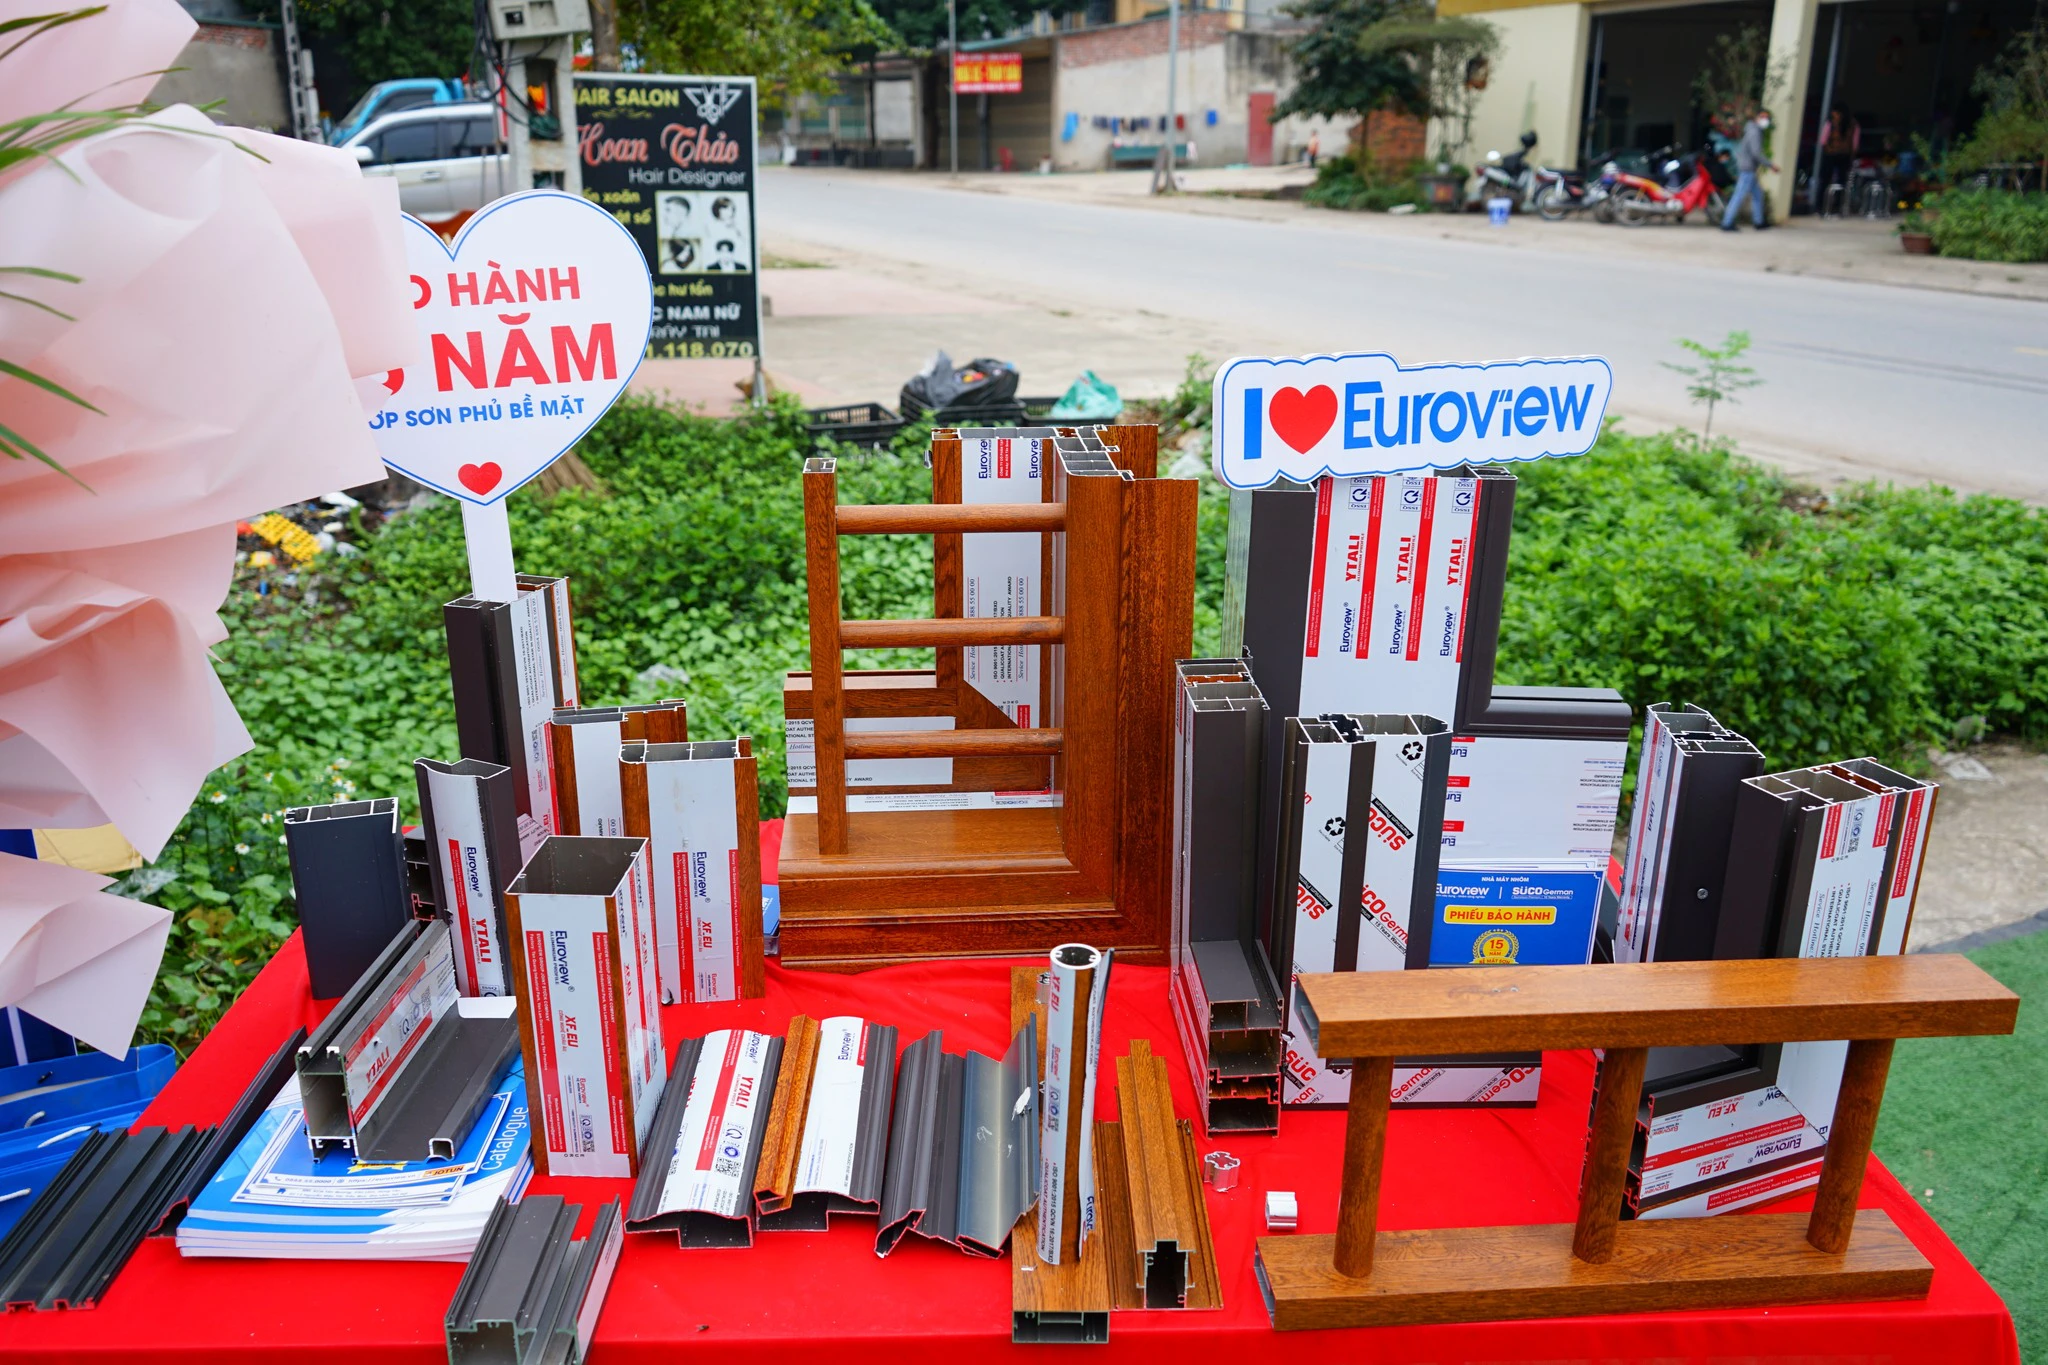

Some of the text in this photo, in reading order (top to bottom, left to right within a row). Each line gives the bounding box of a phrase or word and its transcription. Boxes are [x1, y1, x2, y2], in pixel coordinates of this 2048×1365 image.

[615, 88, 679, 106] SALON
[577, 123, 649, 166] Hoan
[629, 168, 745, 187] Hair Designer
[447, 260, 580, 306] HÀNH
[667, 306, 710, 320] NAM
[714, 302, 741, 320] NỮ
[431, 313, 618, 392] NĂM
[405, 407, 451, 427] SƠN
[459, 398, 502, 422] PHỦ
[510, 393, 534, 418] BỀ
[540, 395, 584, 419] MẶT
[1244, 380, 1594, 460] I Euroview
[1345, 535, 1360, 582] YTALI
[1396, 537, 1411, 584] YTALI
[1447, 539, 1462, 586] YTALI
[1340, 608, 1352, 652] Euroview
[1390, 609, 1402, 654] Euroview
[1440, 612, 1453, 656] Euroview
[467, 847, 479, 892] Euroview
[696, 851, 707, 897] Euroview
[1380, 926, 1391, 938] Years
[1450, 908, 1551, 920] PHIẾU BẢO HÀNH
[1823, 890, 1836, 942] INTERNATIONAL
[476, 918, 491, 963] YTALI
[555, 930, 569, 984] Euroview
[1490, 940, 1504, 949] 15
[365, 1046, 390, 1083] YTALI
[838, 1032, 851, 1060] Euroview
[736, 1076, 754, 1108] YTALI
[1390, 1067, 1433, 1099] Germa
[1409, 1071, 1441, 1098] Years Warranty
[480, 1106, 529, 1170] Catalogue
[1753, 1138, 1800, 1158] Euroview
[433, 1166, 464, 1176] JOTUN
[1040, 1199, 1048, 1252] AUTHENTICATION
